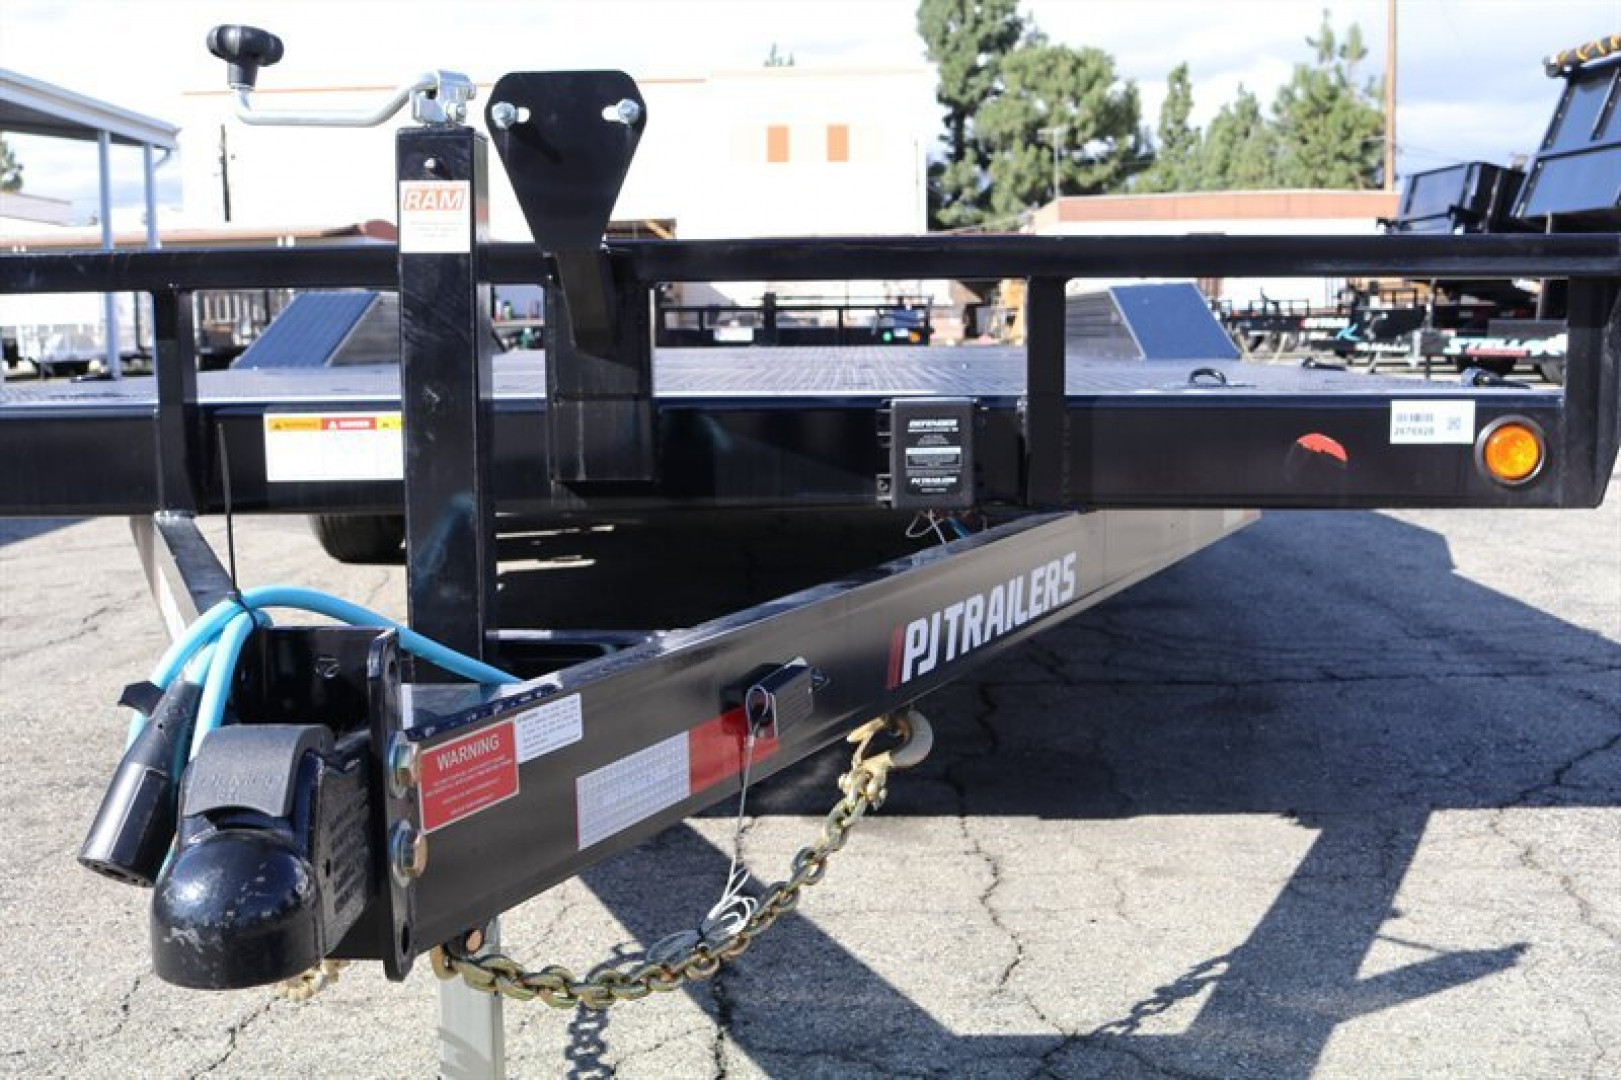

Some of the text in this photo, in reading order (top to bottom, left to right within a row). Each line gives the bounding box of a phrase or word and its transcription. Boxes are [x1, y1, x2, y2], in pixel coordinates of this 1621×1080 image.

[403, 188, 466, 211] RAM
[901, 551, 1077, 684] PJ TRAILERS
[437, 733, 500, 773] WARNING
